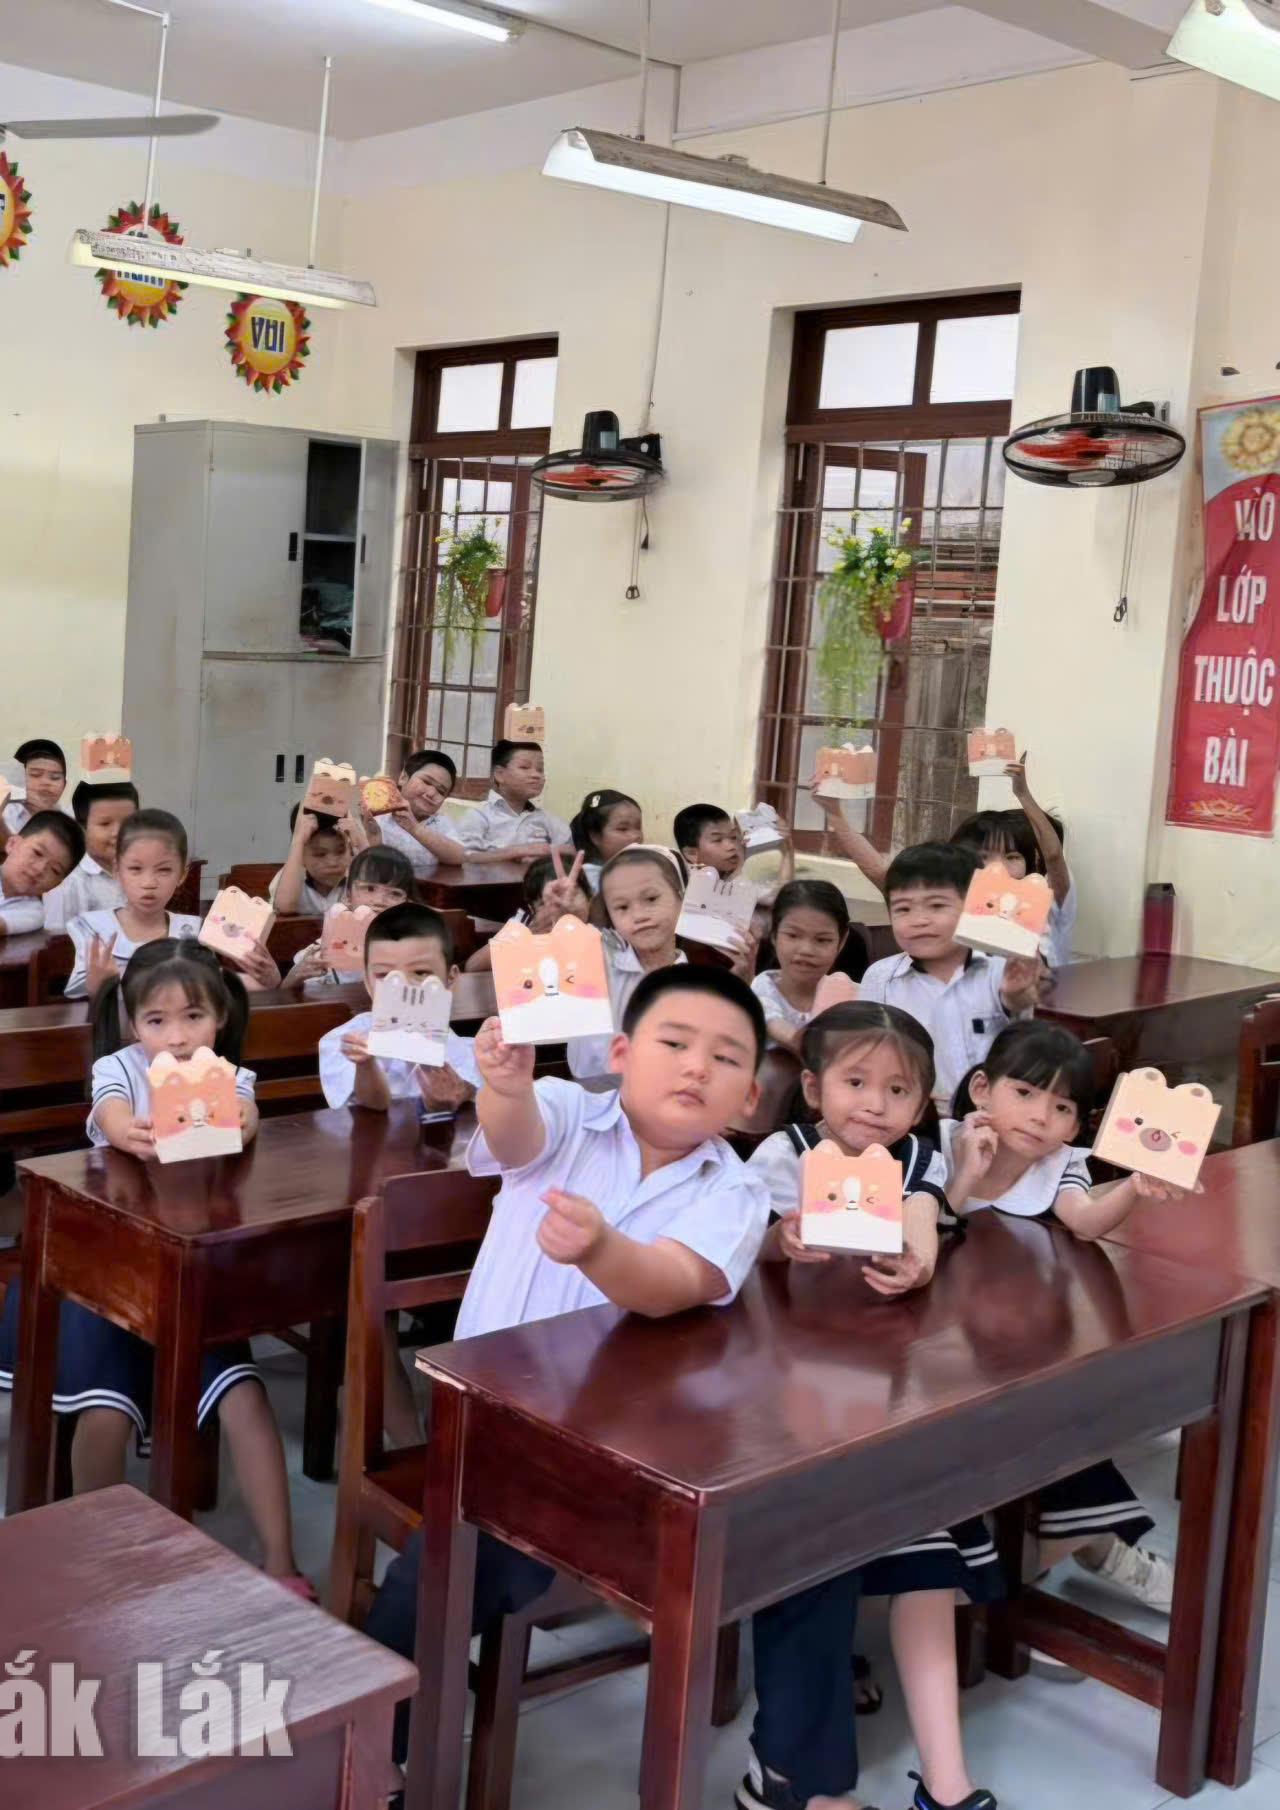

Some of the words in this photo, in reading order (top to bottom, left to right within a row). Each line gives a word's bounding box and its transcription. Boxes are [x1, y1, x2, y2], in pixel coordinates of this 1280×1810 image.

[251, 316, 285, 353] VUI
[1234, 487, 1276, 542] VÀO
[1216, 564, 1268, 624] LỚP
[1194, 647, 1276, 717] THUỘC
[1203, 727, 1249, 788] BÀI
